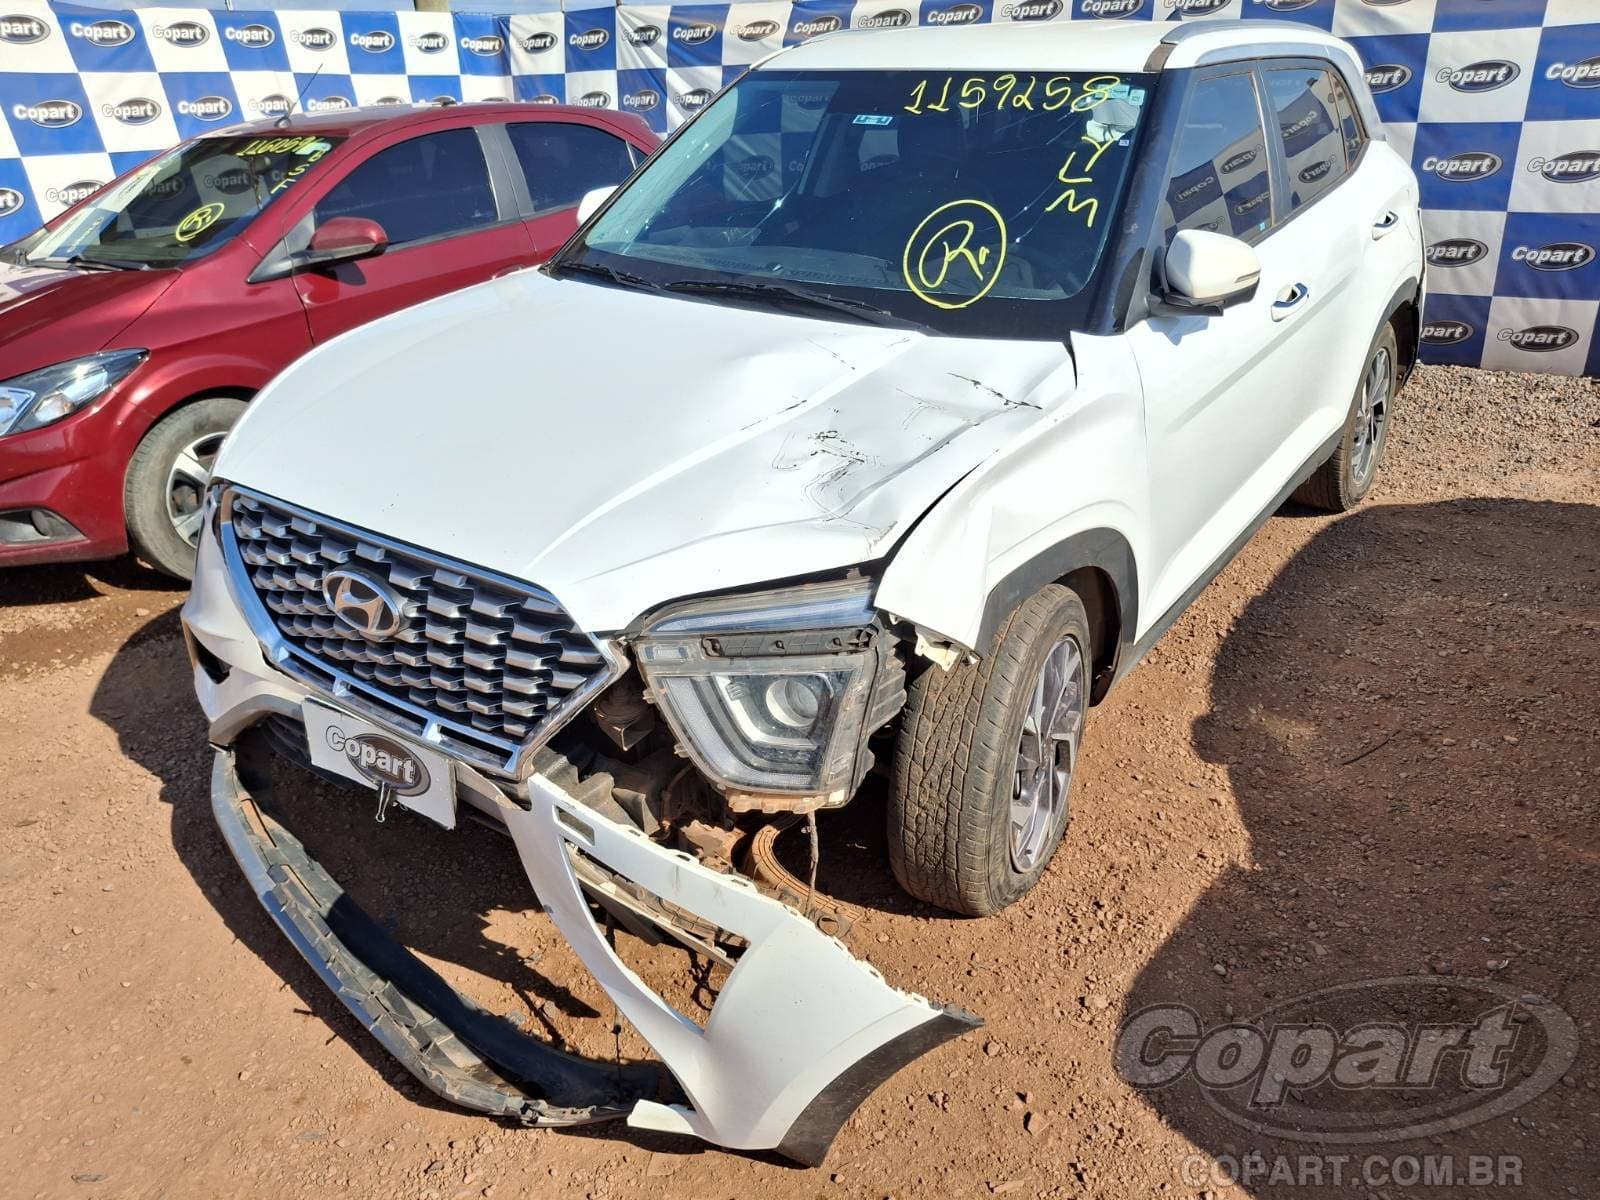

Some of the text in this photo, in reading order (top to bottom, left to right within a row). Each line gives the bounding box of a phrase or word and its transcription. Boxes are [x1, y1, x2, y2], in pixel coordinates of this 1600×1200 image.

[1001, 2, 1054, 20] Copart
[1081, 0, 1136, 13] Copart
[858, 13, 904, 28] Copart
[927, 9, 977, 25] Copart
[0, 21, 41, 37] part
[70, 22, 129, 41] Copart
[153, 25, 201, 41] Copart
[225, 27, 270, 42] Copart
[673, 26, 711, 40] Copart
[732, 22, 771, 38] Copart
[793, 19, 836, 35] Copart
[290, 30, 331, 45] Copart
[350, 33, 390, 47] Copart
[408, 35, 444, 49] Copart
[518, 35, 552, 49] Copart
[569, 31, 604, 47] Copart
[622, 29, 656, 42] Copart
[460, 37, 500, 51] Copart
[1435, 65, 1508, 88] Copart
[1546, 63, 1600, 81] Copa
[623, 95, 655, 107] Copart
[904, 74, 1120, 114] 1159258
[13, 104, 75, 123] Copart
[102, 103, 153, 120] Copart
[177, 100, 226, 116] Copart
[1422, 156, 1493, 174] Copart
[1425, 244, 1477, 260] opart
[1512, 245, 1585, 264] Copart
[1420, 326, 1464, 339] part
[1497, 328, 1568, 345] Copart
[326, 725, 416, 785] Copart
